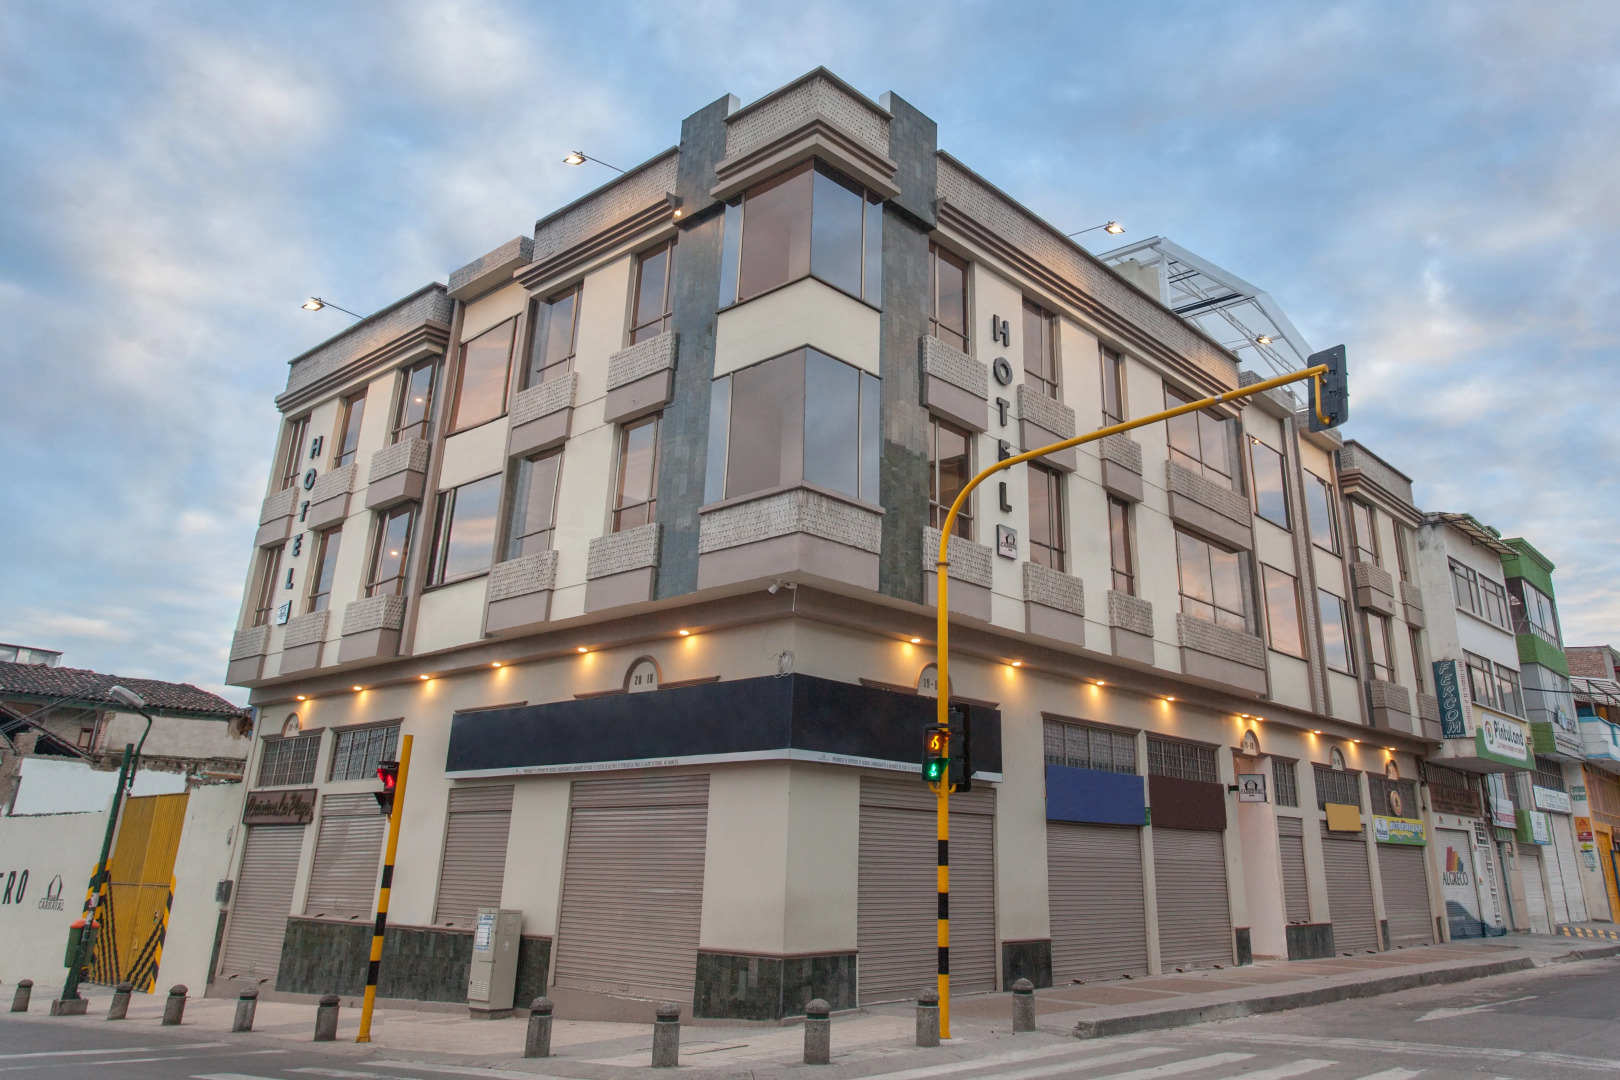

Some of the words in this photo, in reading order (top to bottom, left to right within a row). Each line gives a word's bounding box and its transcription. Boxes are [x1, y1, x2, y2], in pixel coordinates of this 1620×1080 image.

[993, 314, 1013, 513] HOTEL
[285, 435, 324, 590] HOTEL
[1439, 662, 1461, 734] FERCOM
[1443, 871, 1469, 886] ALGRECO
